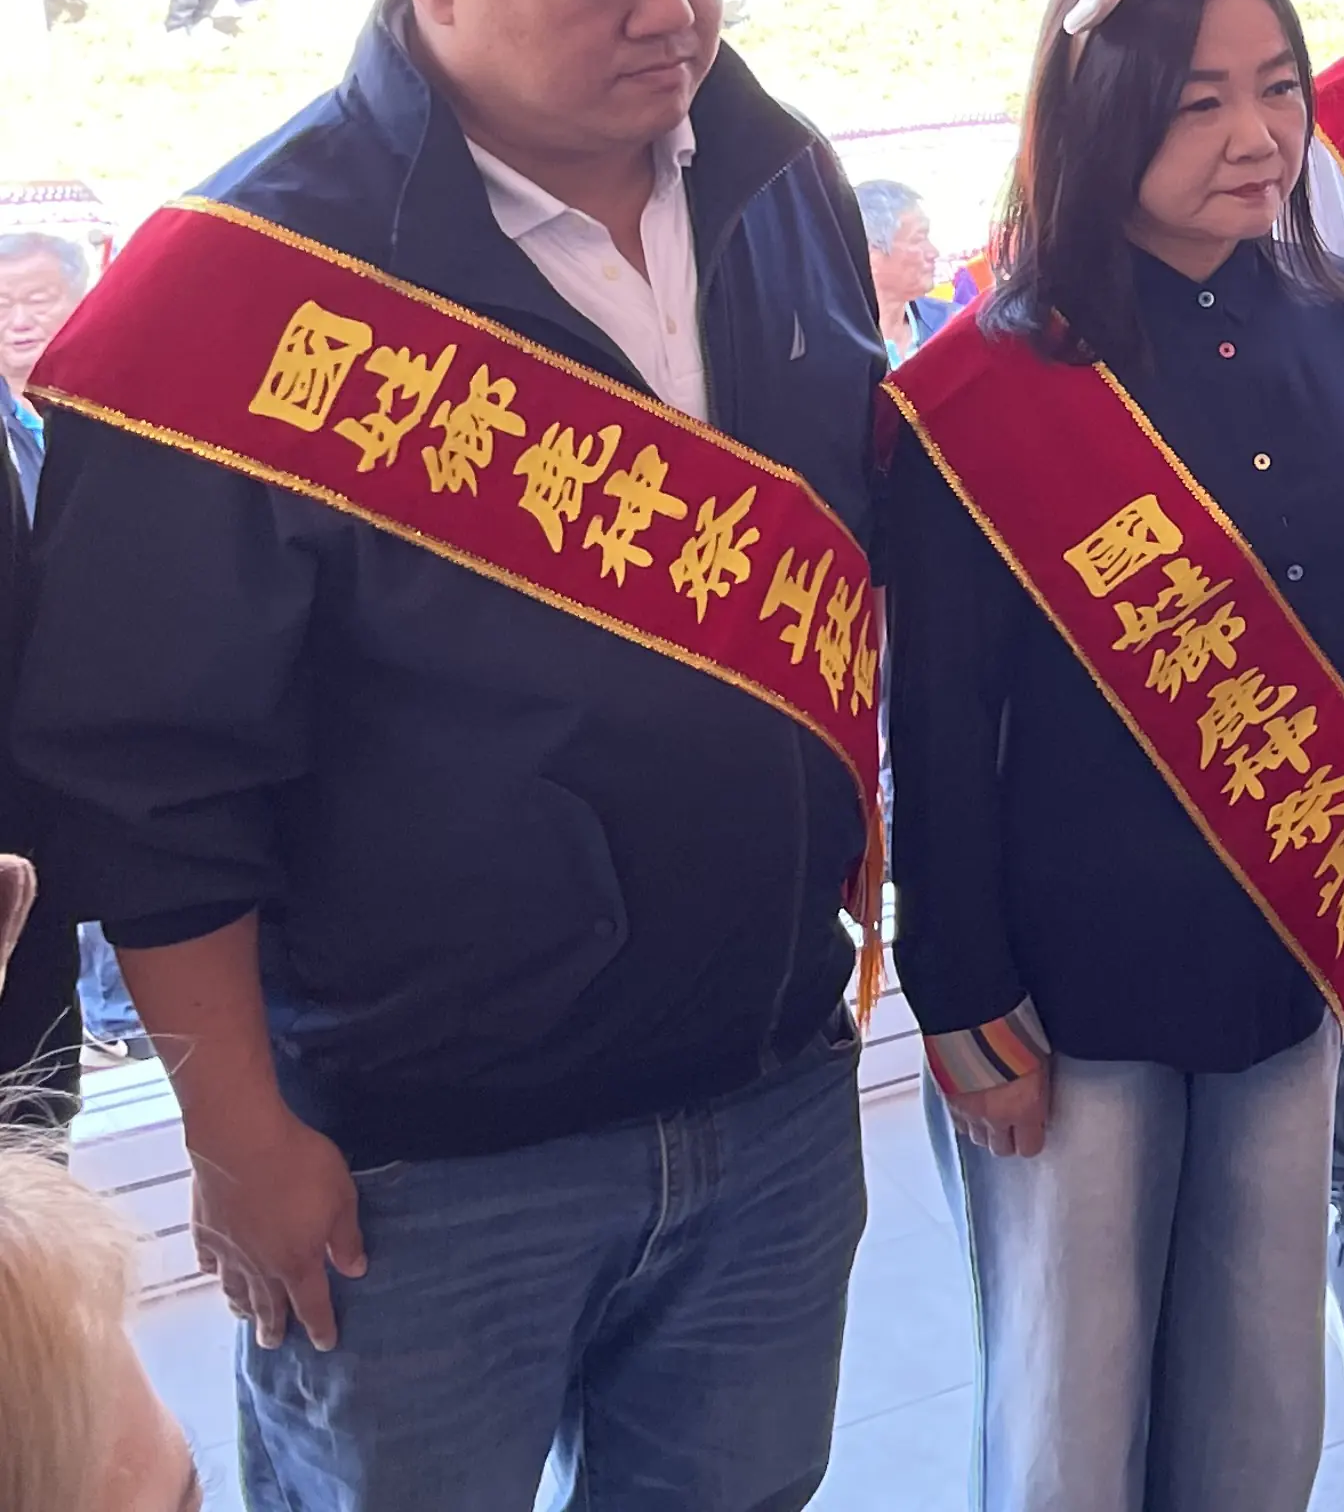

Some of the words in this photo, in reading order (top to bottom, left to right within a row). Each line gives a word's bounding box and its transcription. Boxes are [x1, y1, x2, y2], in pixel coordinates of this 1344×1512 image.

[249, 300, 879, 718] 國姓鄉鹿神祭正獻官
